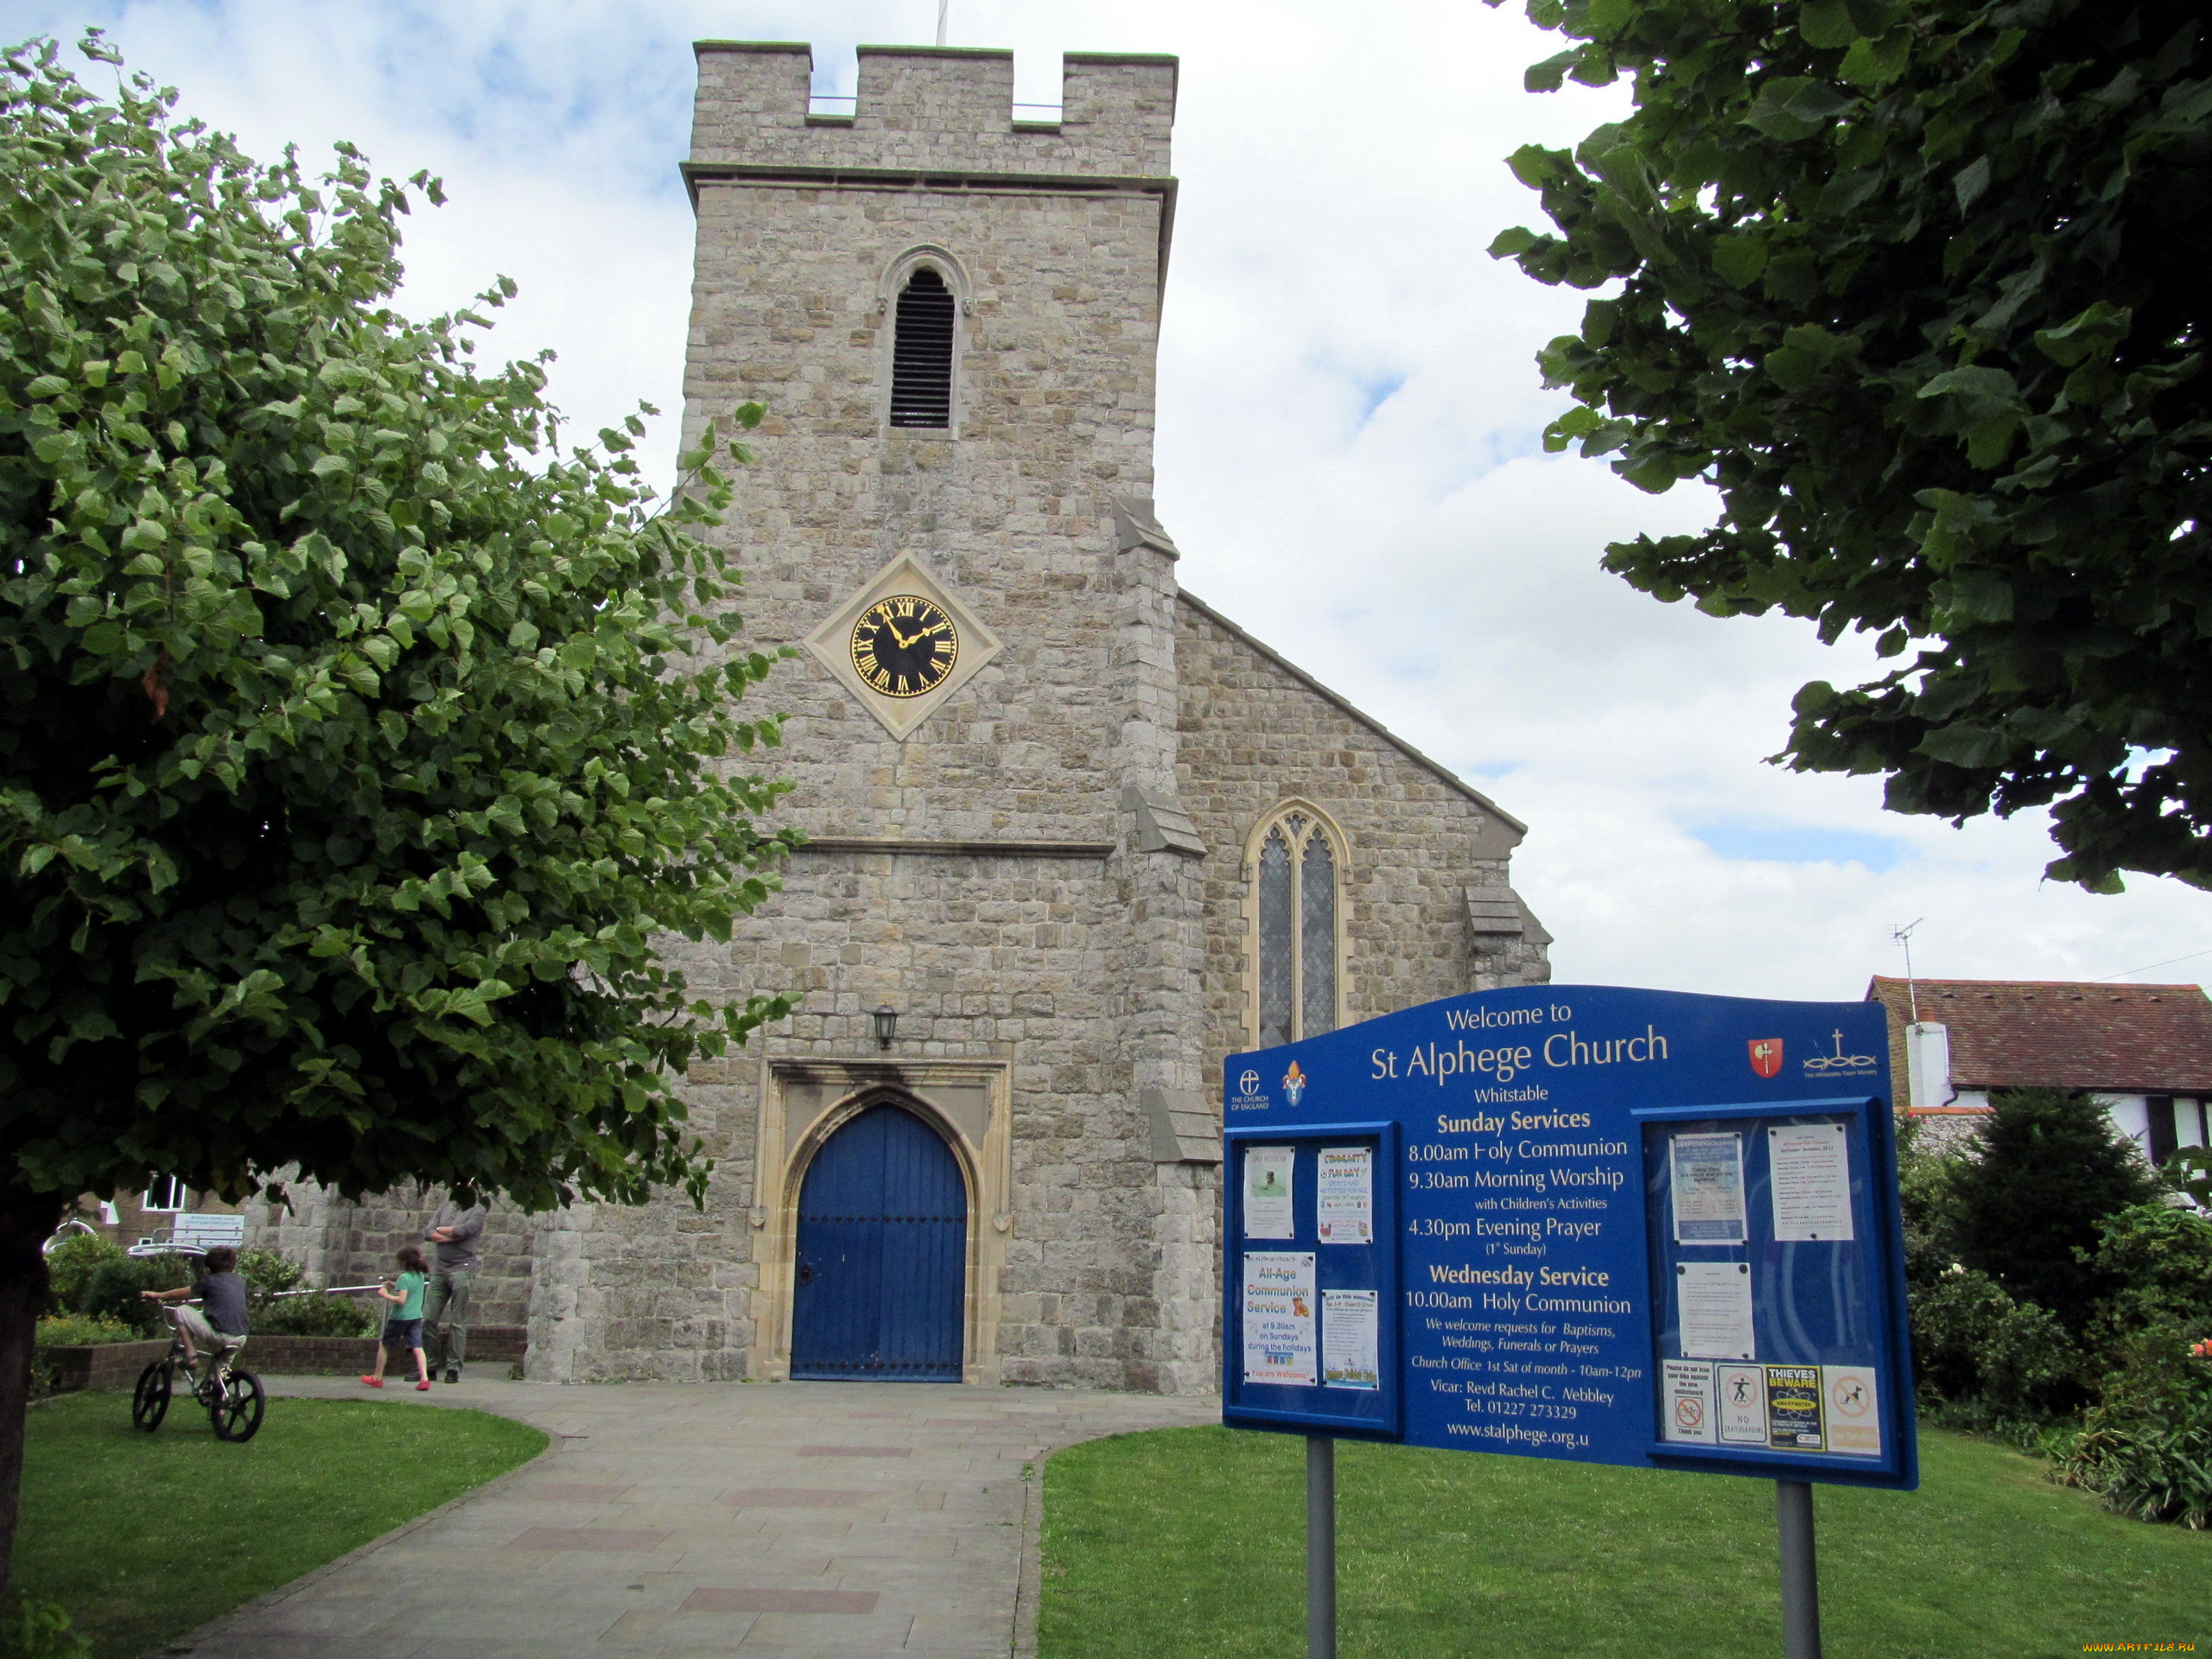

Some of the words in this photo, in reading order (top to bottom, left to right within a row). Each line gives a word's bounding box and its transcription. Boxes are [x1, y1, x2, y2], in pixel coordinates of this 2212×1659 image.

[896, 602, 915, 617] XII
[861, 620, 880, 634] X
[935, 640, 950, 653] III
[1446, 1005, 1542, 1031] Welcome
[1550, 1002, 1572, 1022] to
[1371, 1048, 1398, 1080] St
[1407, 1040, 1532, 1086] Alphege
[1543, 1025, 1668, 1067] Church
[1474, 1084, 1548, 1103] Whitstable
[1438, 1112, 1504, 1137] Sunday
[1511, 1109, 1591, 1130] Services
[1408, 1145, 1468, 1161] 8.00am
[1475, 1140, 1513, 1164] Holy
[1518, 1138, 1628, 1159] Communion
[1325, 1153, 1367, 1164] COMMUNITY
[1329, 1168, 1342, 1178] FUN
[1344, 1166, 1359, 1178] DAY
[1409, 1172, 1469, 1189] 9.30am
[1475, 1170, 1545, 1192] Morning
[1550, 1166, 1624, 1192] Worship
[1475, 1198, 1497, 1210] with
[1500, 1198, 1554, 1210] Children's
[1557, 1197, 1607, 1209] Activities
[1408, 1219, 1470, 1241] 4.30pm
[1477, 1218, 1541, 1241] Evening
[1547, 1218, 1601, 1242] Prayer
[1503, 1243, 1547, 1255] Sunday)
[1259, 1268, 1296, 1281] All-Age
[1429, 1264, 1534, 1291] Wednesday
[1540, 1266, 1609, 1287] Service
[1247, 1284, 1309, 1296] Communion
[1247, 1300, 1286, 1313] Service
[1406, 1291, 1472, 1308] 10.00am
[1484, 1293, 1521, 1315] Holy
[1526, 1294, 1630, 1313] Communion
[1270, 1322, 1295, 1331] 9.30am
[1426, 1318, 1442, 1329] We
[1445, 1320, 1491, 1332] welcome
[1494, 1323, 1538, 1337] requests
[1541, 1322, 1556, 1334] for
[1563, 1323, 1616, 1338] Baptisms,
[1269, 1332, 1299, 1342] Sundays
[1248, 1343, 1269, 1351] during
[1282, 1344, 1312, 1353] holidays
[1442, 1336, 1494, 1352] Weddings,
[1498, 1338, 1541, 1351] Funerals
[1545, 1343, 1556, 1352] or
[1560, 1341, 1599, 1357] Prayers
[1411, 1356, 1447, 1368] Church
[1451, 1357, 1482, 1370] Office
[1487, 1360, 1500, 1372] 1st
[1503, 1361, 1518, 1373] Sat
[1521, 1362, 1532, 1374] of
[1535, 1363, 1567, 1376] month
[1276, 1370, 1309, 1379] Welcome!
[1769, 1369, 1815, 1379] THIEVES
[1431, 1379, 1463, 1393] Vicar:
[1467, 1382, 1495, 1395] Revd
[1499, 1383, 1538, 1398] Rachel
[1541, 1386, 1555, 1400] C.
[1465, 1399, 1484, 1413] Tel.
[1488, 1402, 1525, 1415] 01227
[1530, 1403, 1577, 1419] 273329
[1724, 1425, 1764, 1434] SKATEBOARDING
